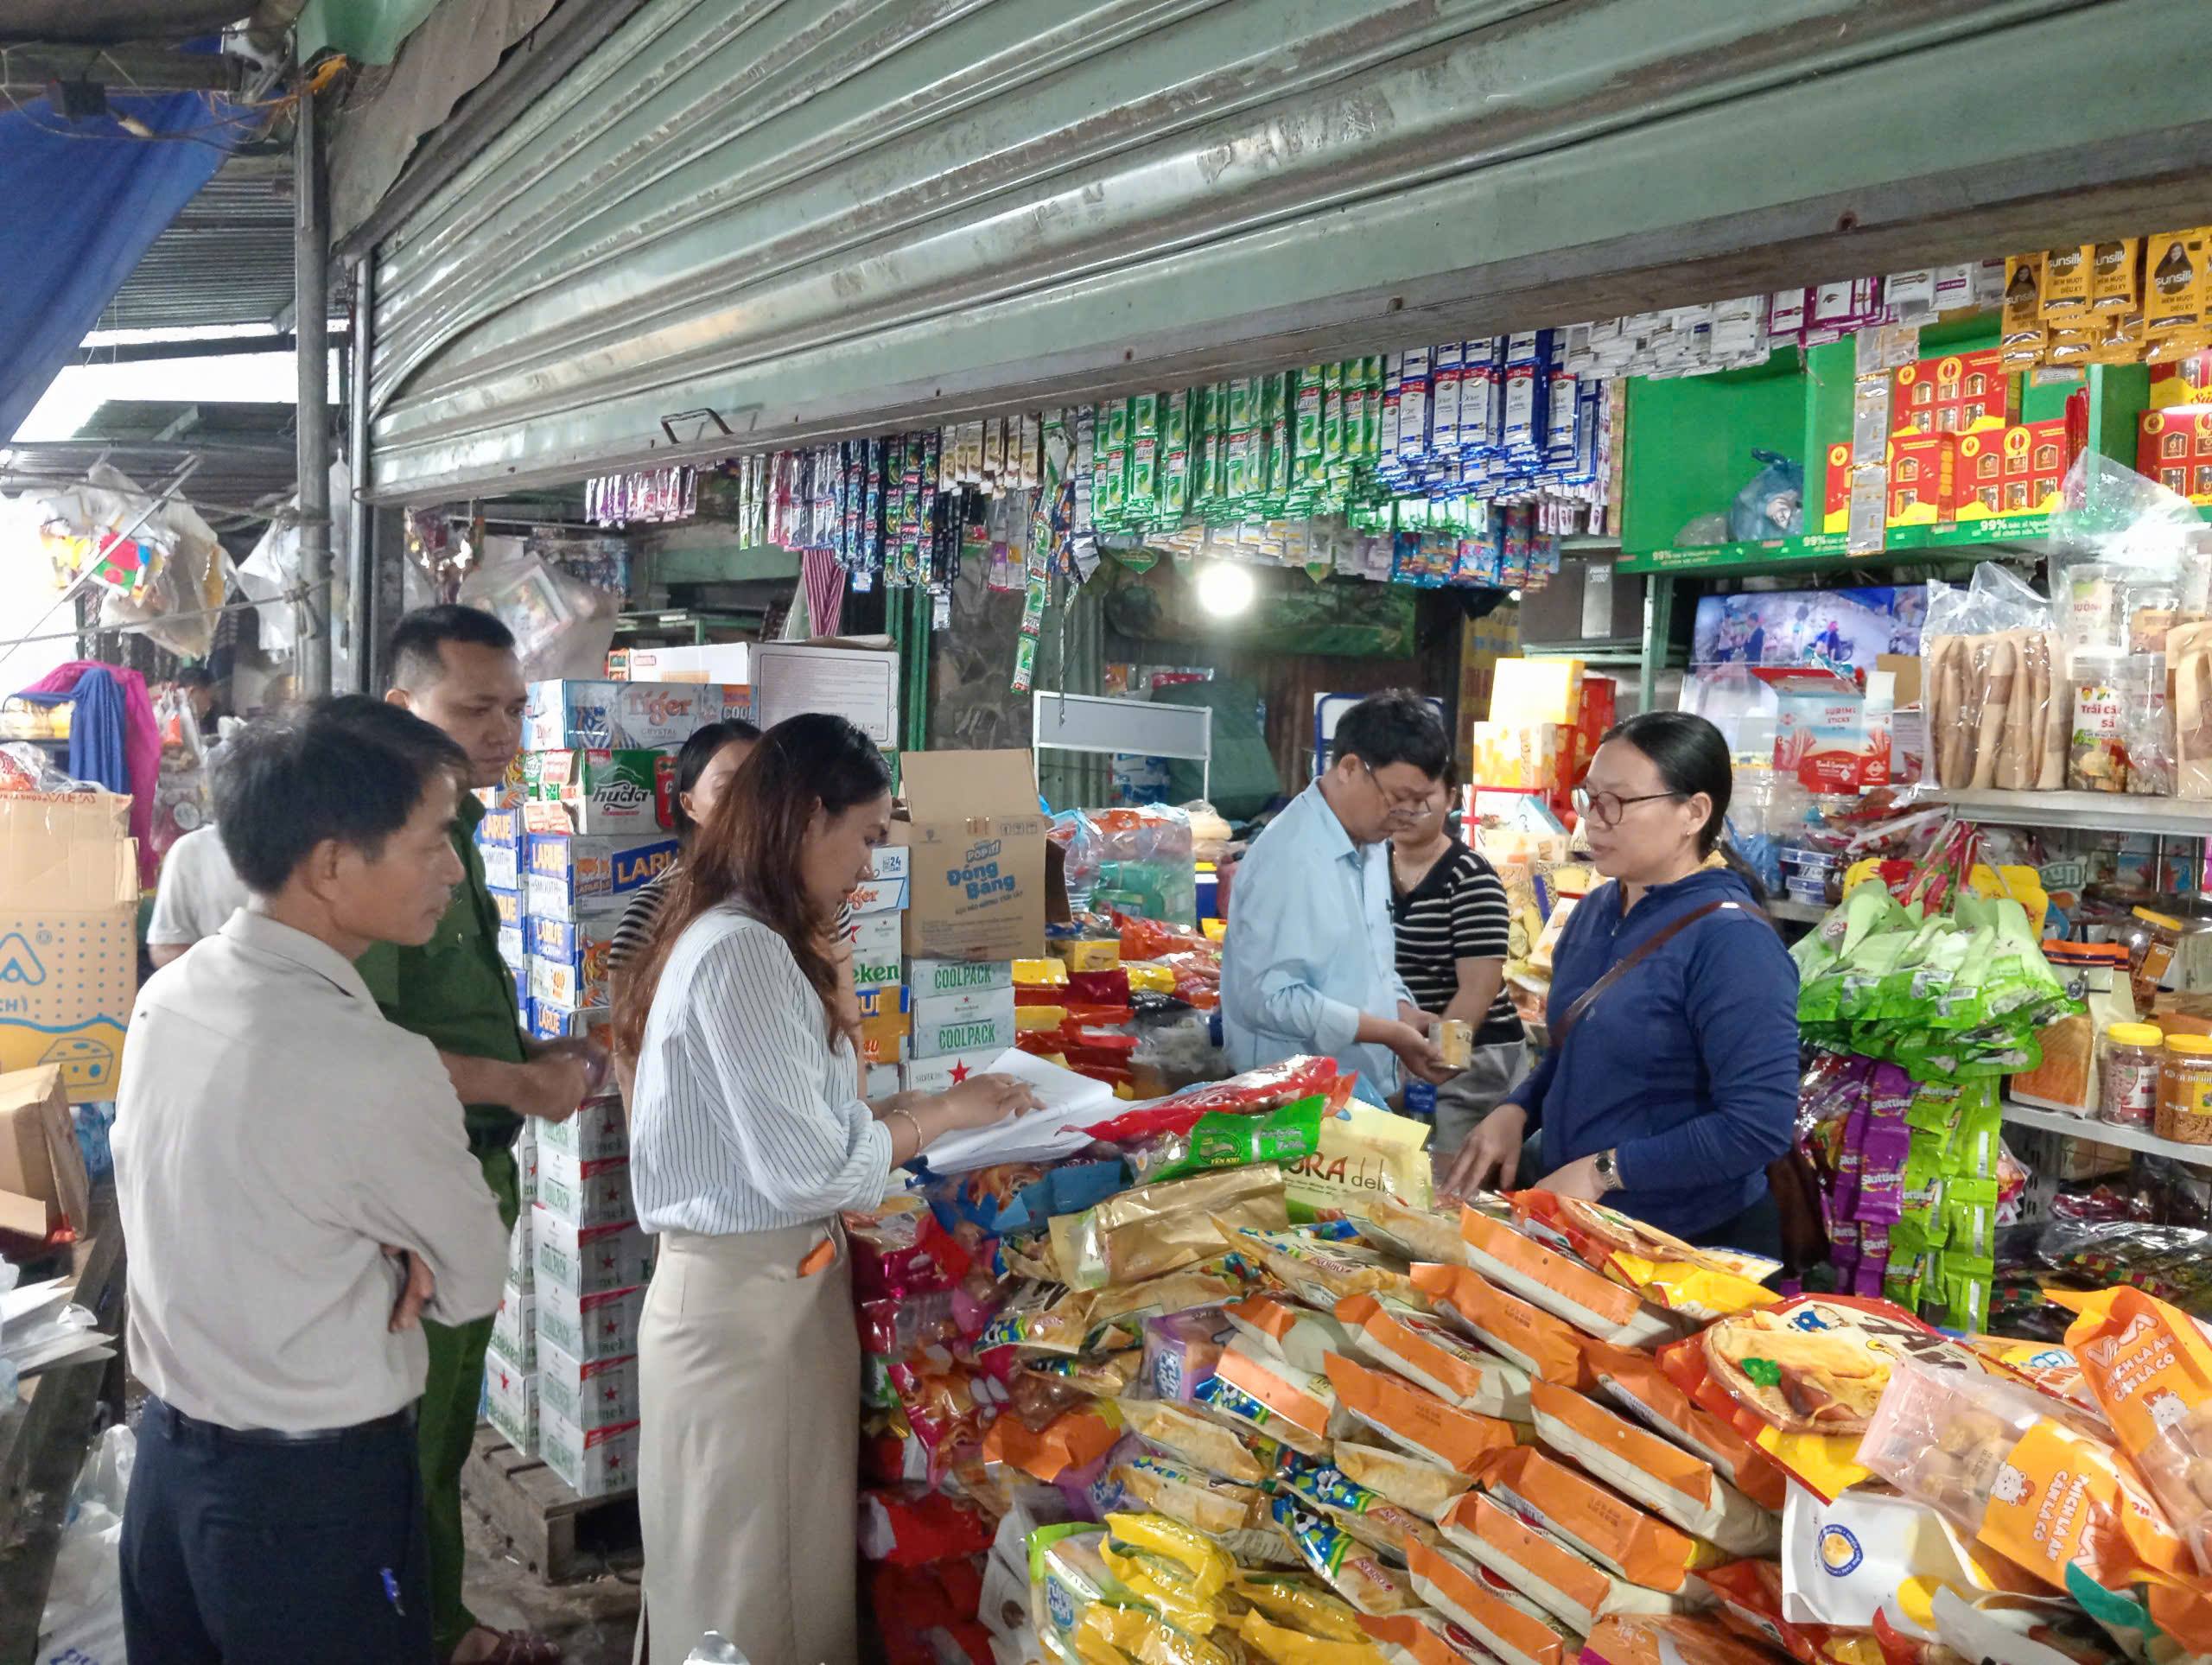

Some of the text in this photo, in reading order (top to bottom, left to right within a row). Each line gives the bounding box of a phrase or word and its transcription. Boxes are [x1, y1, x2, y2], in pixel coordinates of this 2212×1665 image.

[2094, 251, 2126, 266] unsilk
[2156, 270, 2193, 286] sunsilk
[532, 842, 563, 870] LARUE
[617, 849, 678, 884] LARU
[853, 963, 899, 983] eken
[934, 964, 992, 989] COOLPACK
[939, 1024, 995, 1050] COOLPACK
[1288, 1151, 1348, 1184] URA
